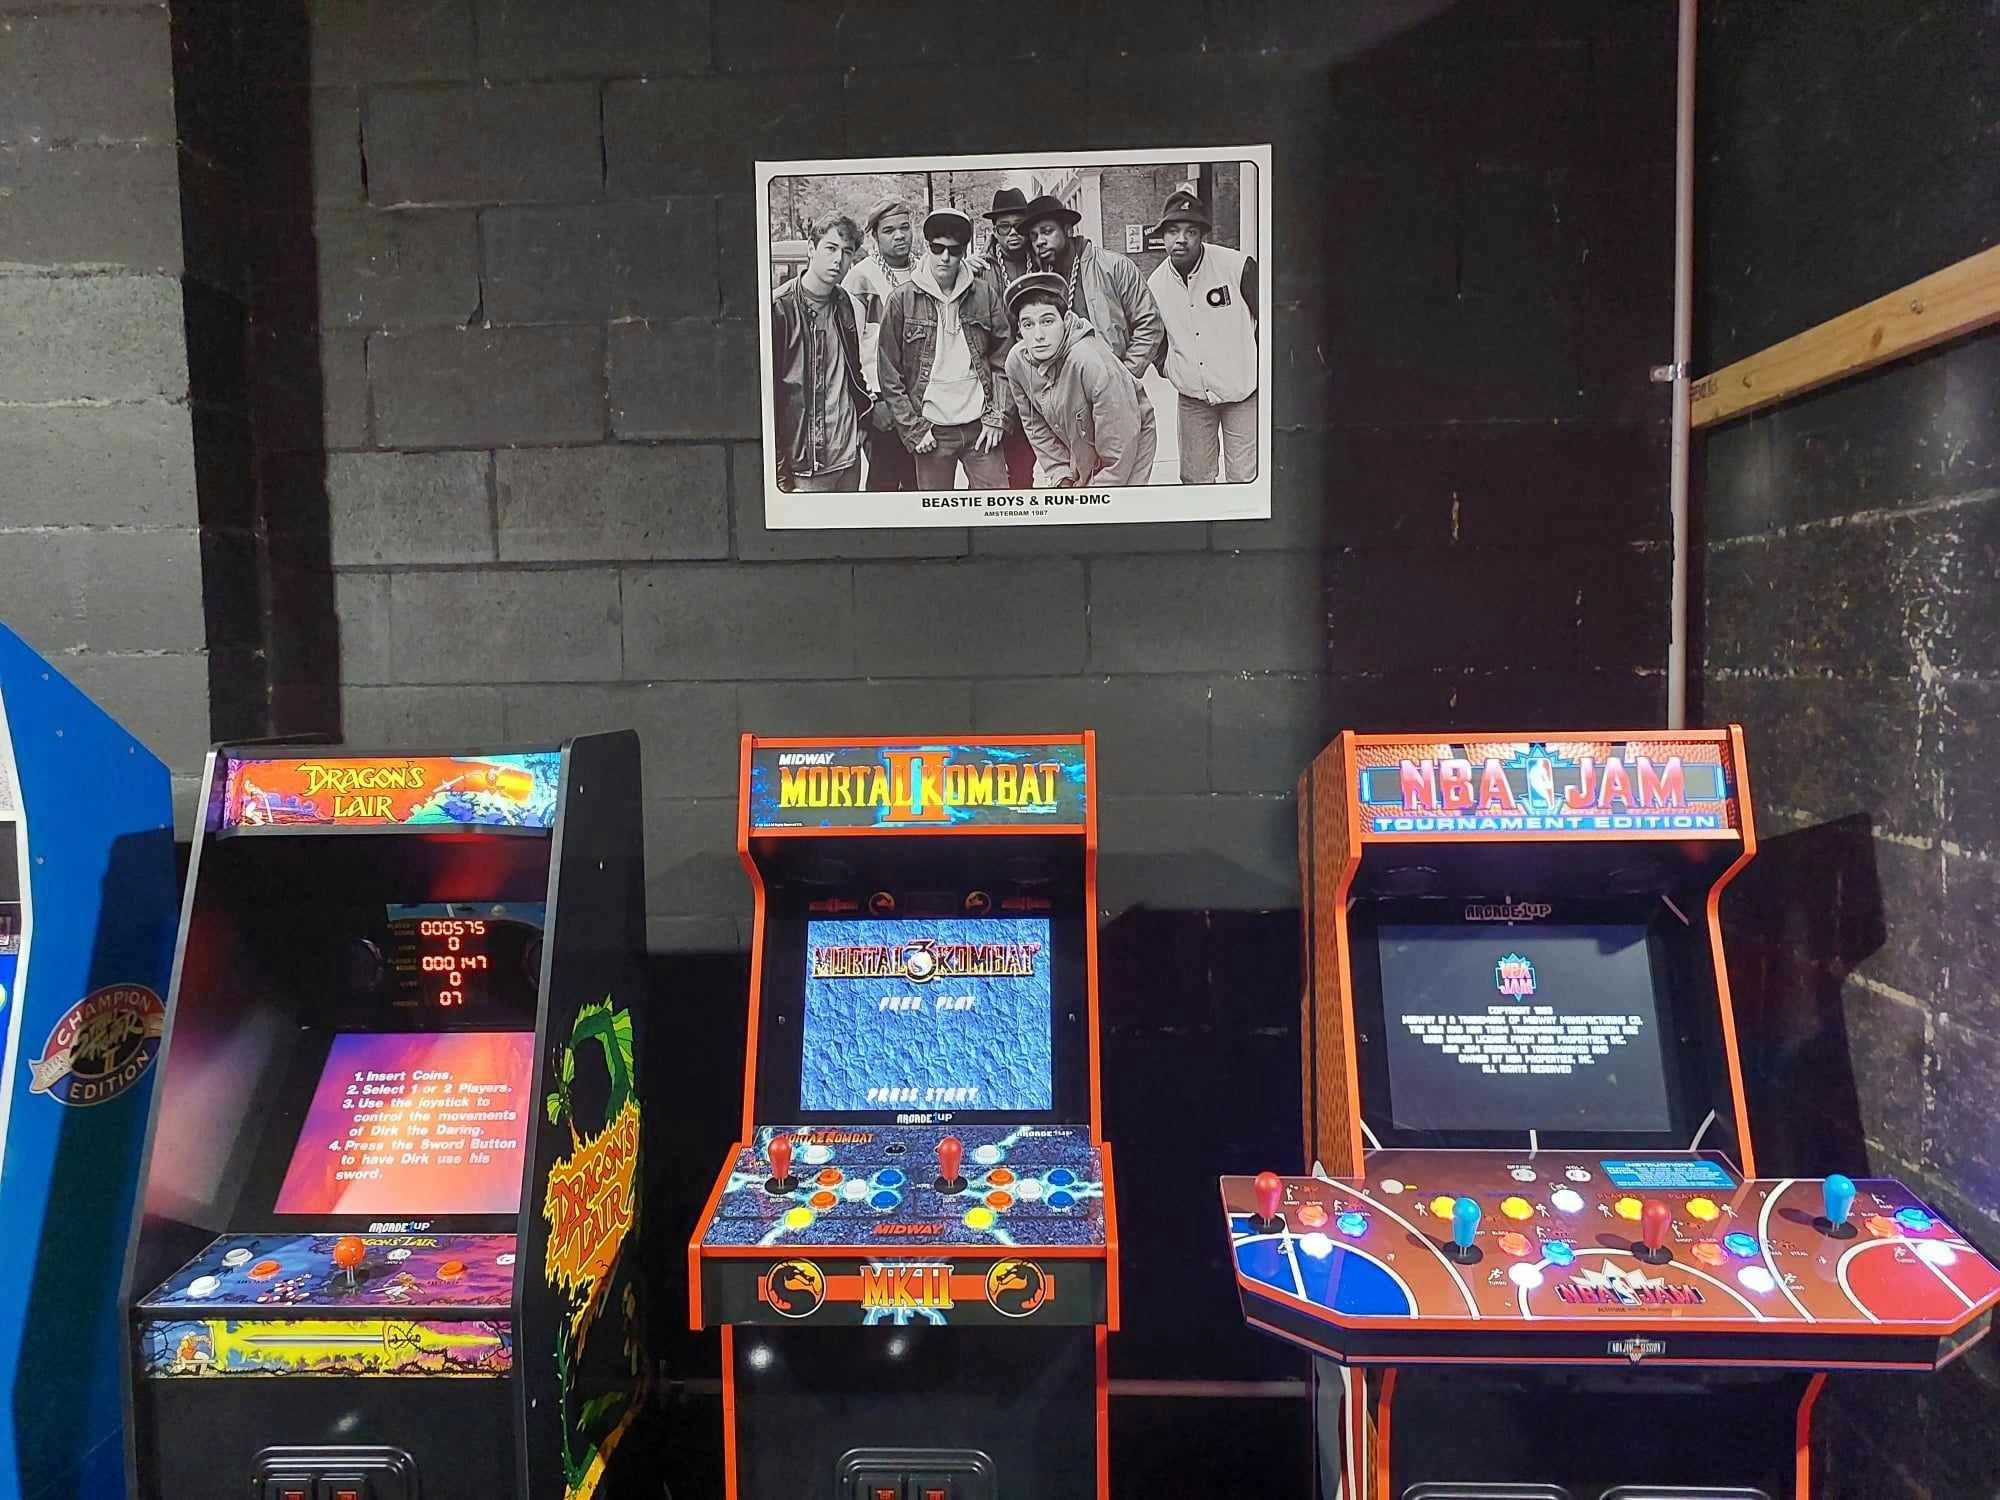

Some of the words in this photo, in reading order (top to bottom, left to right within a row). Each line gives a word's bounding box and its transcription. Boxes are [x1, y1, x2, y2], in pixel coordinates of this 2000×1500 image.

[922, 497, 982, 508] BEASTIE
[987, 496, 1024, 507] BOYS
[1029, 496, 1039, 506] &
[1044, 494, 1111, 506] RUN-DMC
[778, 752, 834, 765] MIDWAY
[297, 760, 426, 797] DRAGON'S
[778, 765, 913, 808] MORTAL
[919, 764, 1060, 808] KOMBAT
[1400, 758, 1518, 811] NBA
[1564, 757, 1689, 810] JAM
[331, 795, 398, 823] LAIR
[1376, 817, 1586, 831] TOURNAMENT
[1594, 815, 1716, 830] EDITION
[421, 921, 485, 936] 000575
[813, 946, 905, 978] MORTAL
[935, 943, 1036, 976] KOMBAT
[1500, 978, 1534, 994] JAM
[57, 991, 151, 1046] CHAMPION
[1523, 1015, 1556, 1024] MIDWAY
[69, 1049, 150, 1100] EDITION
[366, 1071, 406, 1082] Insert
[413, 1070, 453, 1081] Coins.
[346, 1085, 359, 1095] 2.
[362, 1084, 404, 1095] Select
[411, 1085, 418, 1093] 1
[422, 1086, 436, 1095] or
[443, 1084, 452, 1093] 2
[459, 1083, 512, 1095] Players.
[343, 1098, 355, 1109] 3.
[358, 1098, 384, 1109] Use
[391, 1097, 413, 1108] the
[418, 1097, 469, 1109] joystick
[477, 1097, 491, 1106] to
[353, 1111, 402, 1122] control
[409, 1111, 431, 1121] the
[439, 1110, 516, 1121] movements
[349, 1125, 364, 1136] of
[370, 1125, 399, 1136] Dirk
[407, 1125, 429, 1136] the
[436, 1124, 485, 1137] Daring.
[328, 1140, 342, 1151] 4.
[344, 1140, 384, 1151] Press
[391, 1139, 413, 1150] the
[420, 1138, 465, 1150] Sword
[470, 1138, 516, 1149] Button
[341, 1154, 355, 1165] to
[362, 1153, 394, 1165] have
[401, 1153, 429, 1165] Dirk
[437, 1155, 462, 1165] use
[468, 1152, 490, 1164] his
[335, 1169, 384, 1181] sword.
[551, 1114, 636, 1258] DRAGON'S
[577, 1185, 630, 1272] LAIR
[874, 1224, 945, 1236] MIDWAY
[860, 1265, 954, 1309] MKII
[1557, 1284, 1618, 1304] NBA
[1639, 1284, 1702, 1304] JAM
